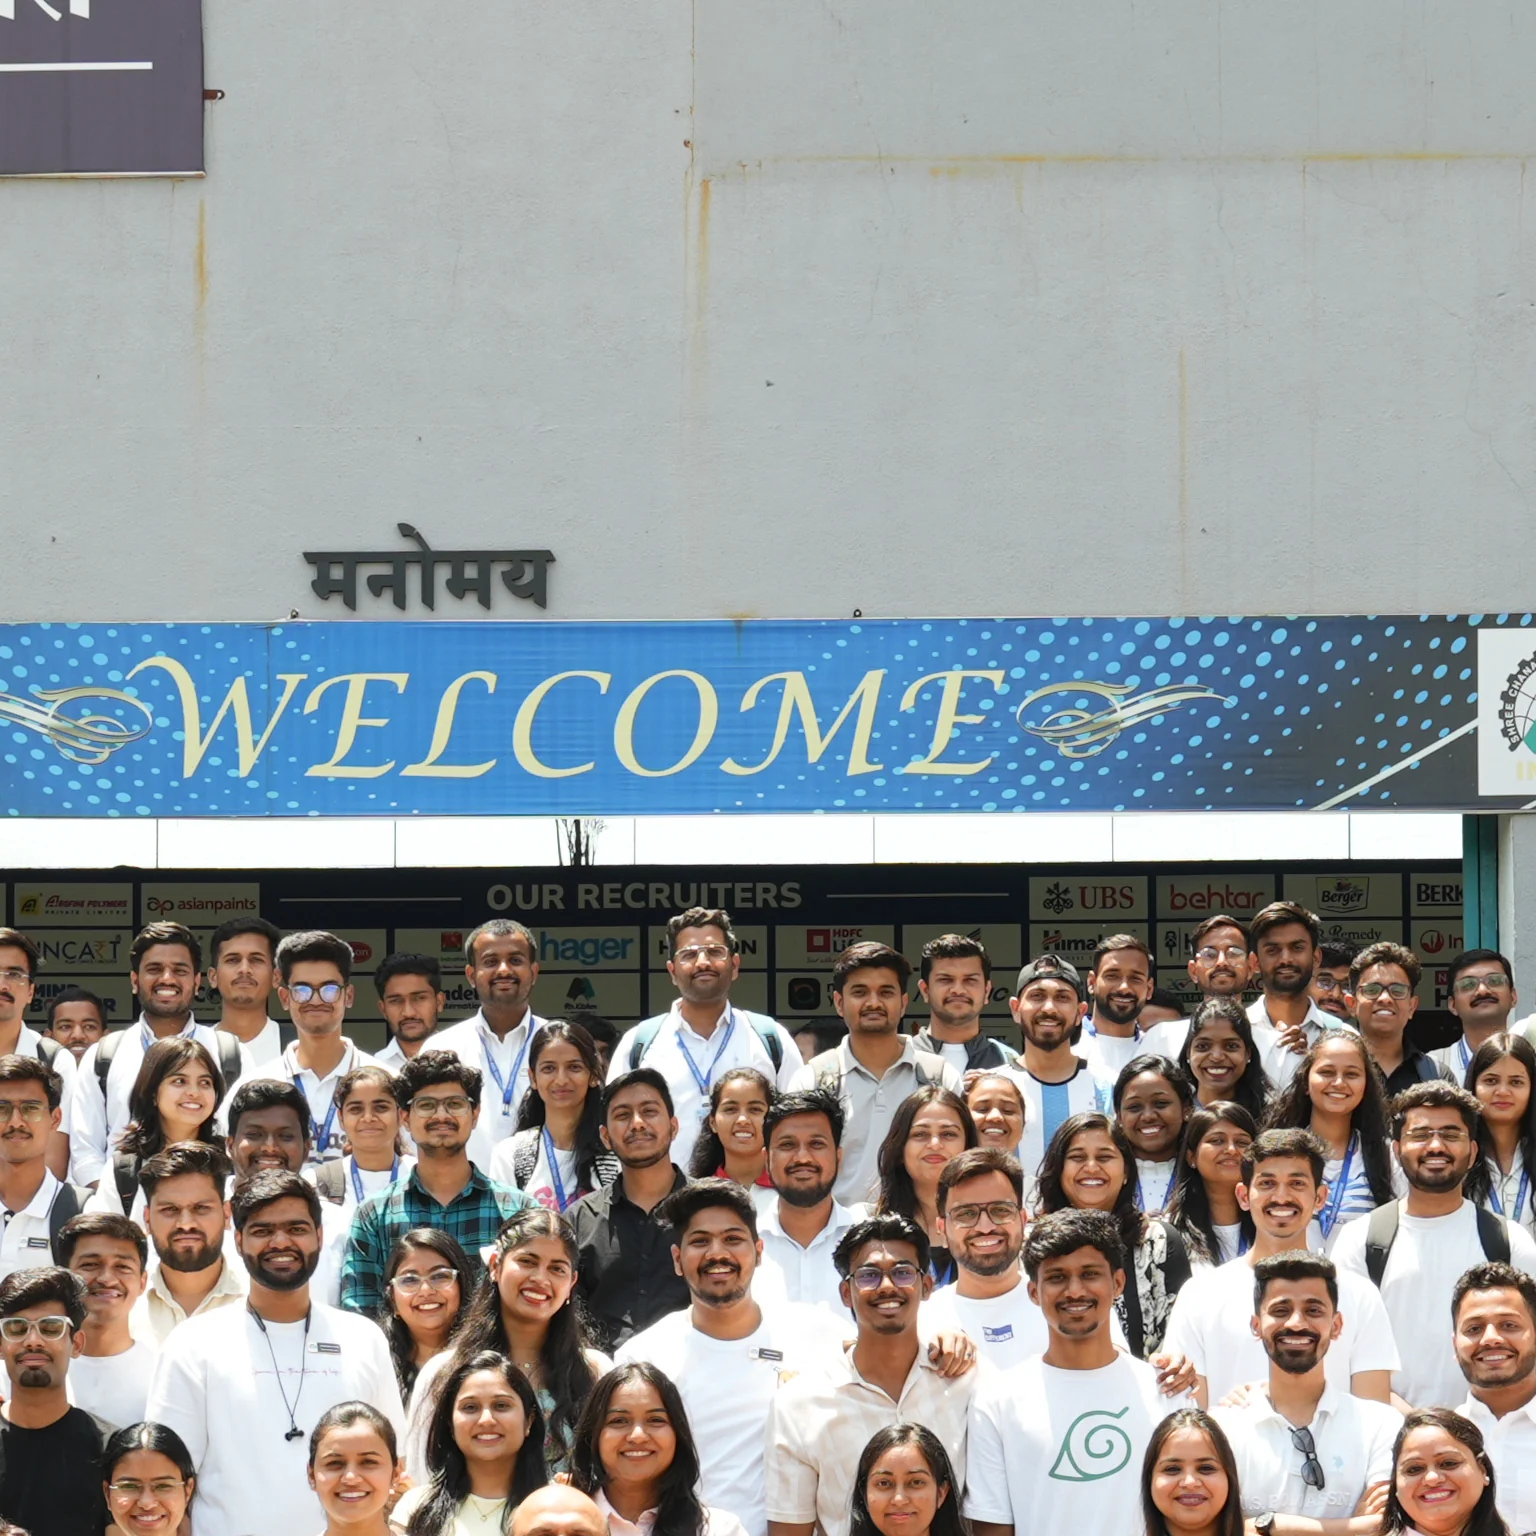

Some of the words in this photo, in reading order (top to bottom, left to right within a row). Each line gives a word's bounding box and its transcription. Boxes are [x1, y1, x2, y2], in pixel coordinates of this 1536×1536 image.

[304, 524, 555, 609] मनोमय
[125, 657, 1007, 780] WELCOME
[1504, 702, 1520, 744] SHREE
[486, 884, 565, 911] OUR
[577, 882, 803, 910] RECRUITERS
[1079, 886, 1134, 910] UBS
[1170, 884, 1265, 910] behtar
[1321, 891, 1365, 906] Berger
[1417, 884, 1463, 902] BERK
[178, 897, 256, 915] asianpaints
[833, 929, 863, 938] HDFC
[1042, 930, 1101, 951] Himal
[540, 931, 634, 965] hager
